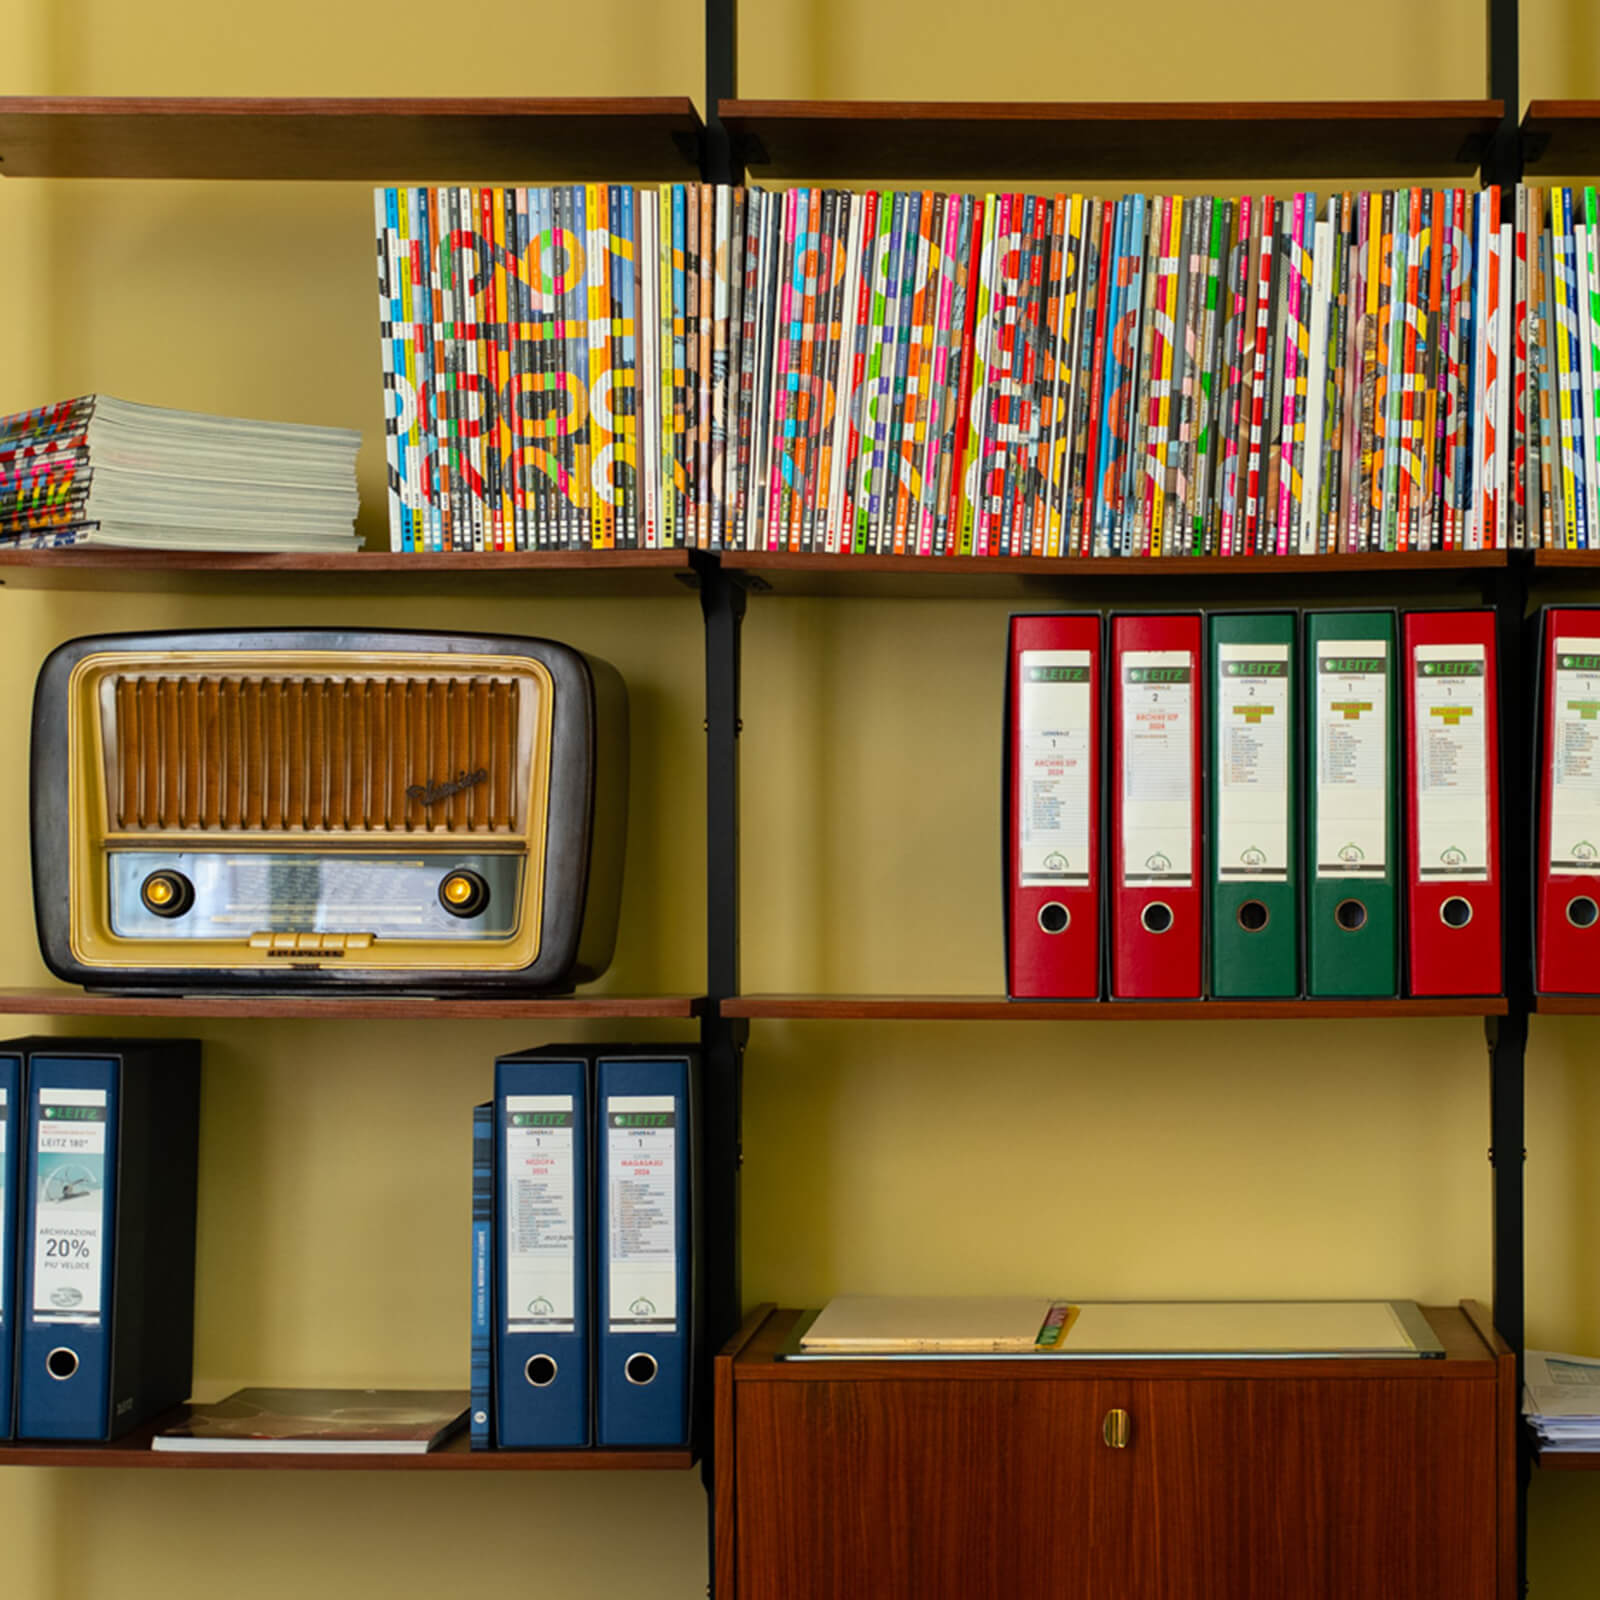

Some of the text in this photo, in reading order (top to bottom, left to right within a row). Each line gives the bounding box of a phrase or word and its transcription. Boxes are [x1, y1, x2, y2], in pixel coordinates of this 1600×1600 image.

[417, 229, 498, 510] 2015
[495, 229, 588, 508] 2016
[589, 228, 698, 508] 2017
[1336, 659, 1379, 671] LEITZ
[1575, 656, 1600, 668] LEI
[1039, 668, 1084, 681] LEITZ
[1142, 669, 1185, 681] LEITZ
[1239, 663, 1281, 675] LEITZ
[1436, 663, 1478, 675] LEITZ
[56, 1108, 97, 1120] LEITZ
[525, 1114, 567, 1126] LEITZ
[626, 1114, 667, 1126] LEITZ
[41, 1138, 67, 1148] LEITZ
[46, 1238, 90, 1258] 20%
[61, 1262, 90, 1270] VELOCE
